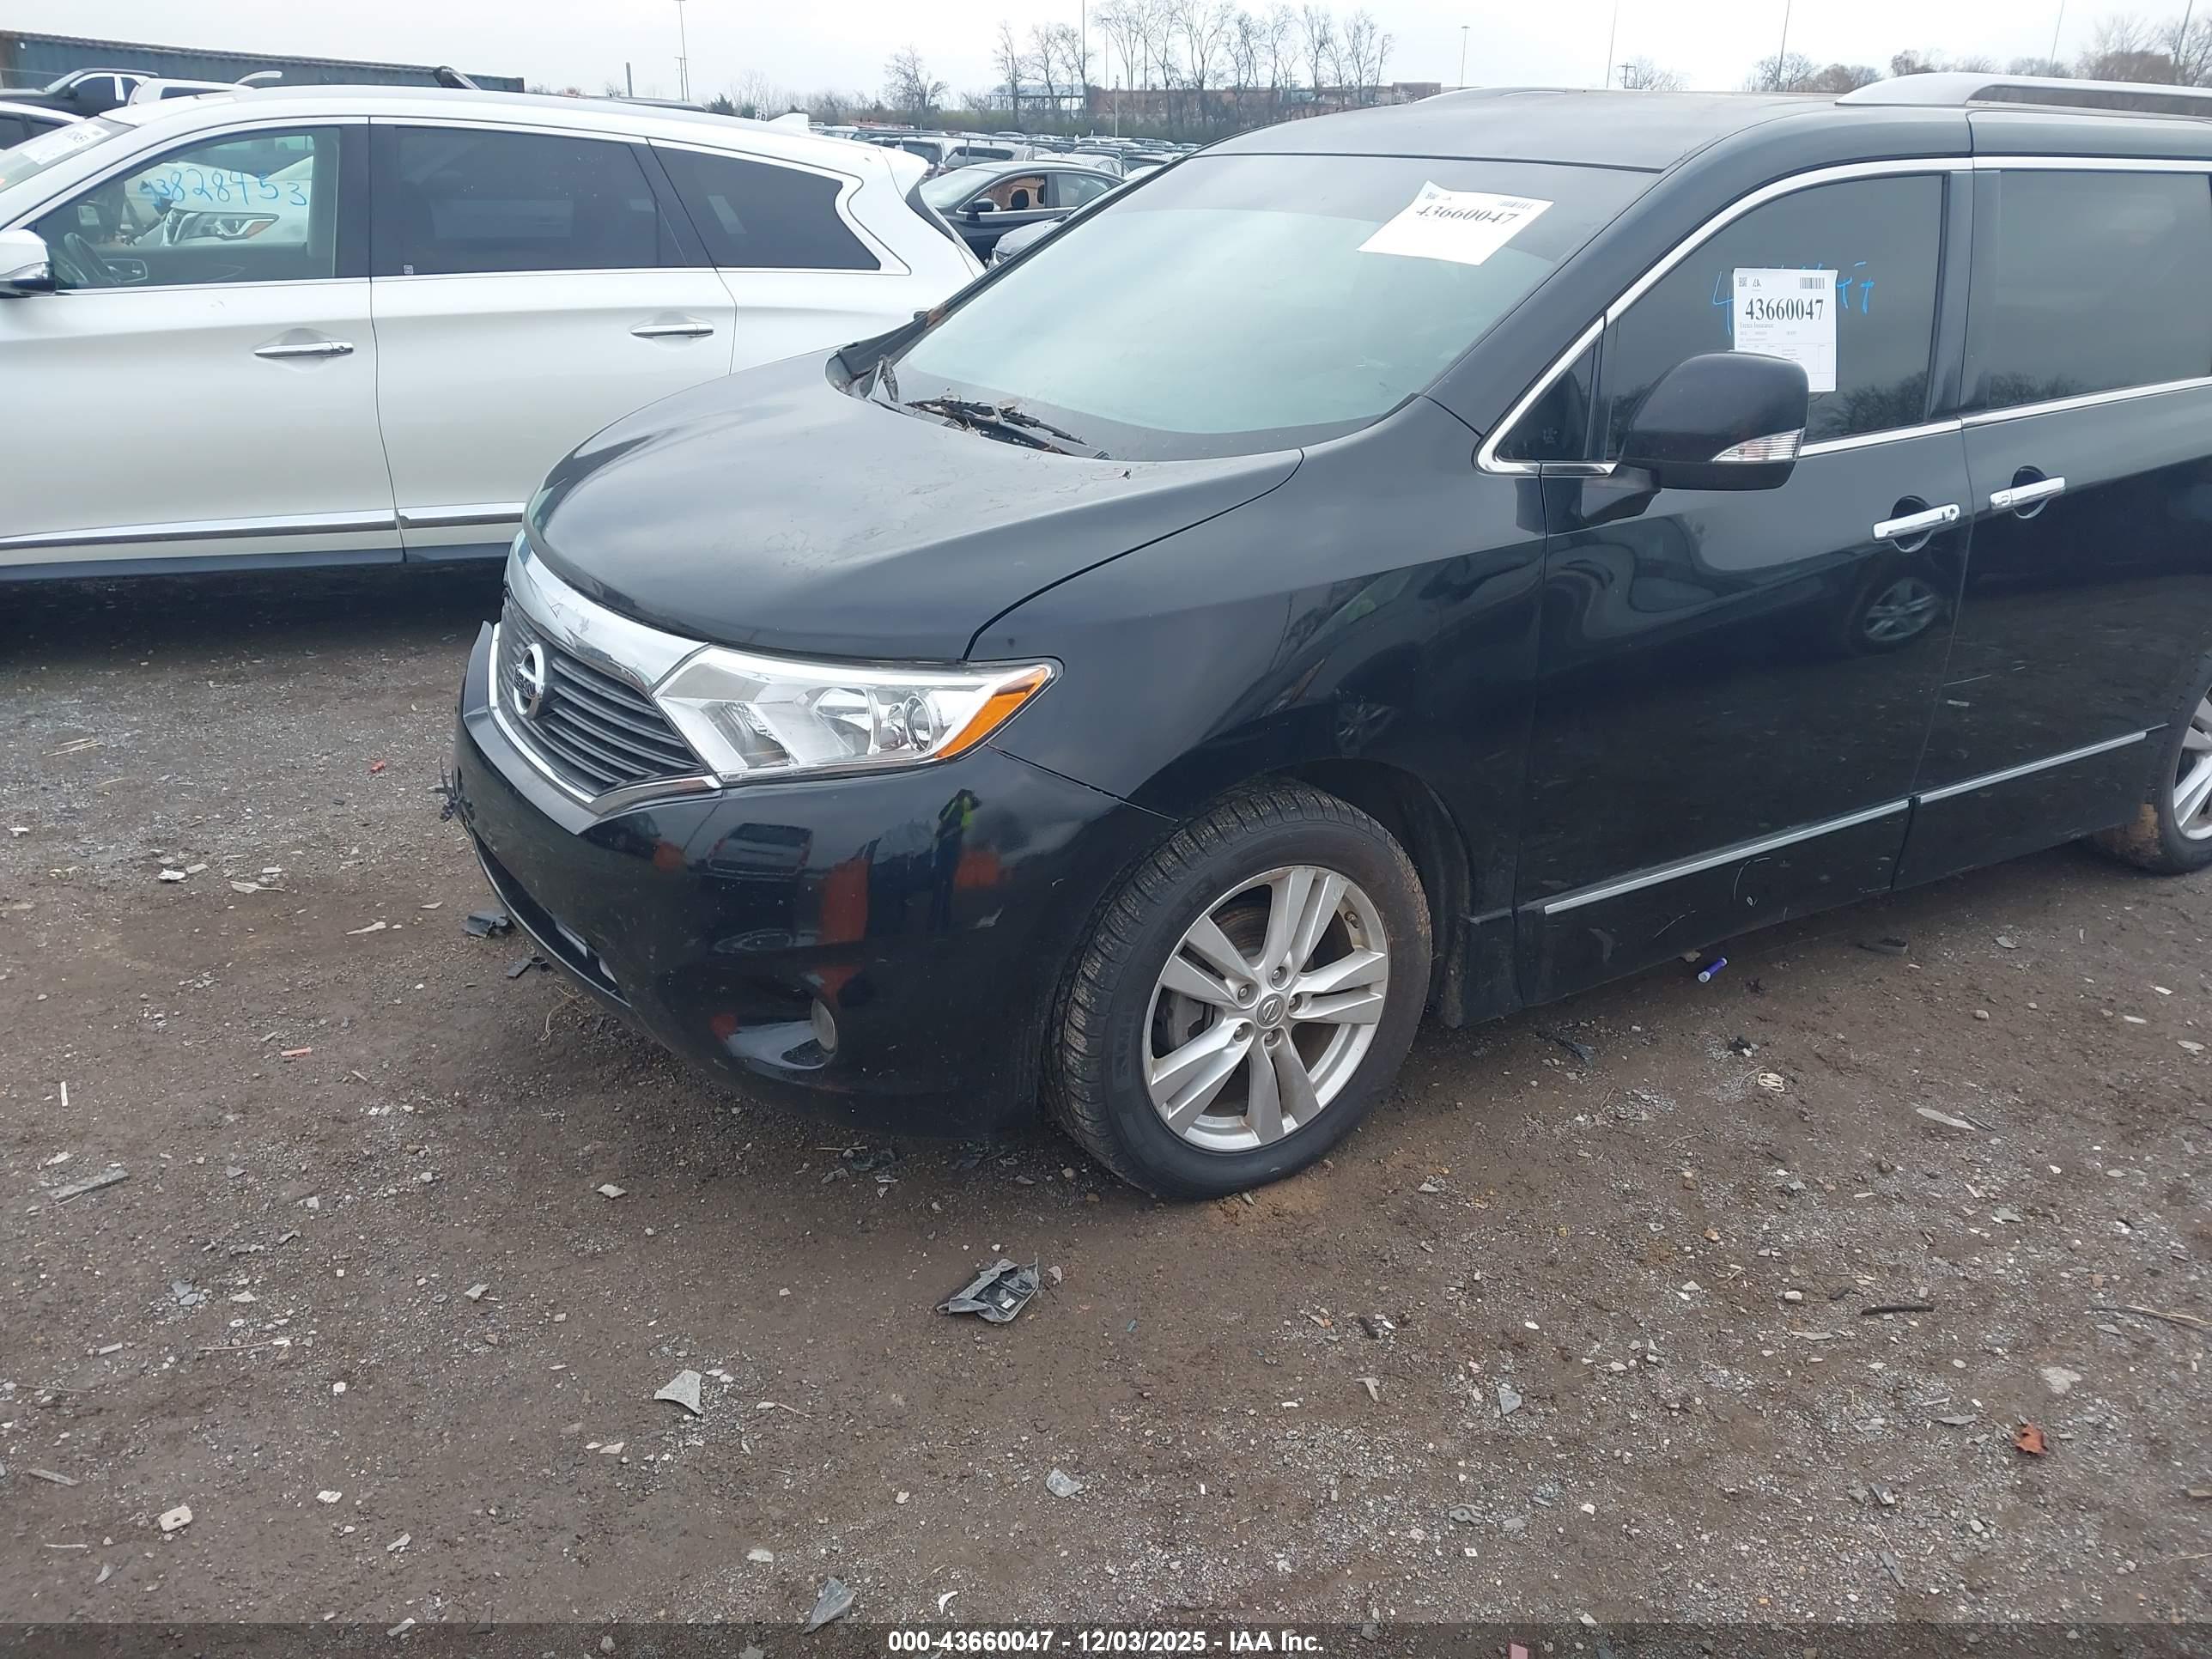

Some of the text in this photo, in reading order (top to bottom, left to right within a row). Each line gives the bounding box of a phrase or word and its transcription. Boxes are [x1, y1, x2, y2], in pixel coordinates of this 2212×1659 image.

[139, 168, 307, 206] 43828453
[1416, 204, 1521, 224] 43660047
[1745, 297, 1824, 321] 43660047
